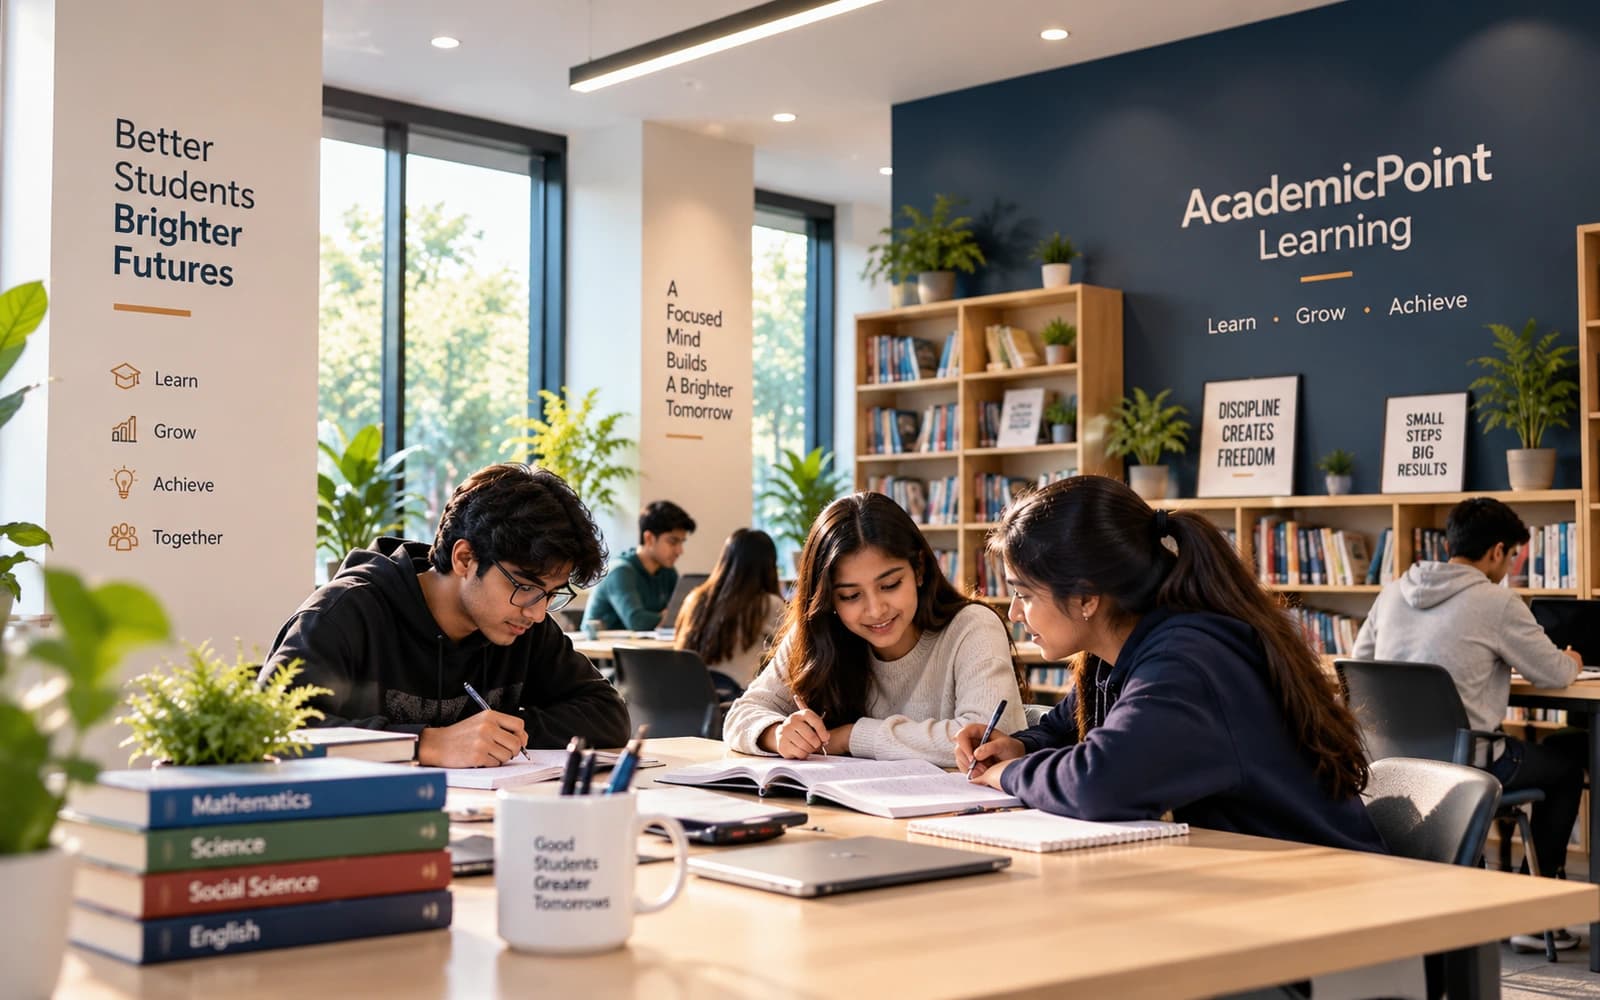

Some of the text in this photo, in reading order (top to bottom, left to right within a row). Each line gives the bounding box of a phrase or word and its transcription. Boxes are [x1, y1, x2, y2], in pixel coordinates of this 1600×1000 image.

[116, 118, 214, 162] Better
[114, 161, 255, 209] Students
[1181, 143, 1493, 228] AcademicPoint
[114, 203, 243, 247] Brighter
[1259, 213, 1412, 260] Learning
[113, 245, 234, 287] Futures
[667, 280, 678, 297] A
[667, 303, 723, 327] Focused
[1208, 293, 1468, 334] Learn Grow Achieve
[666, 327, 701, 348] Mind
[666, 351, 708, 372] Builds
[155, 371, 198, 388] Learn
[666, 376, 734, 400] A Brighter
[666, 399, 733, 421] Tomorrow
[1218, 398, 1281, 420] DISCIPLINE
[1405, 411, 1445, 427] SMALL
[154, 423, 196, 440] Grow
[1222, 422, 1275, 443] CREATES
[1406, 428, 1443, 443] STEPS
[1217, 447, 1276, 468] FREEDOM
[1411, 445, 1434, 460] BIG
[1397, 462, 1448, 477] RESULTS
[153, 476, 215, 493] Achieve
[152, 529, 223, 549] Together
[191, 788, 312, 816] Mathematics
[190, 836, 266, 859] Science
[534, 836, 576, 852] Good
[534, 856, 599, 872] Students
[189, 874, 320, 903] Social Science
[533, 875, 592, 892] Greater
[533, 894, 611, 911] Tomorrows
[188, 919, 261, 950] English
